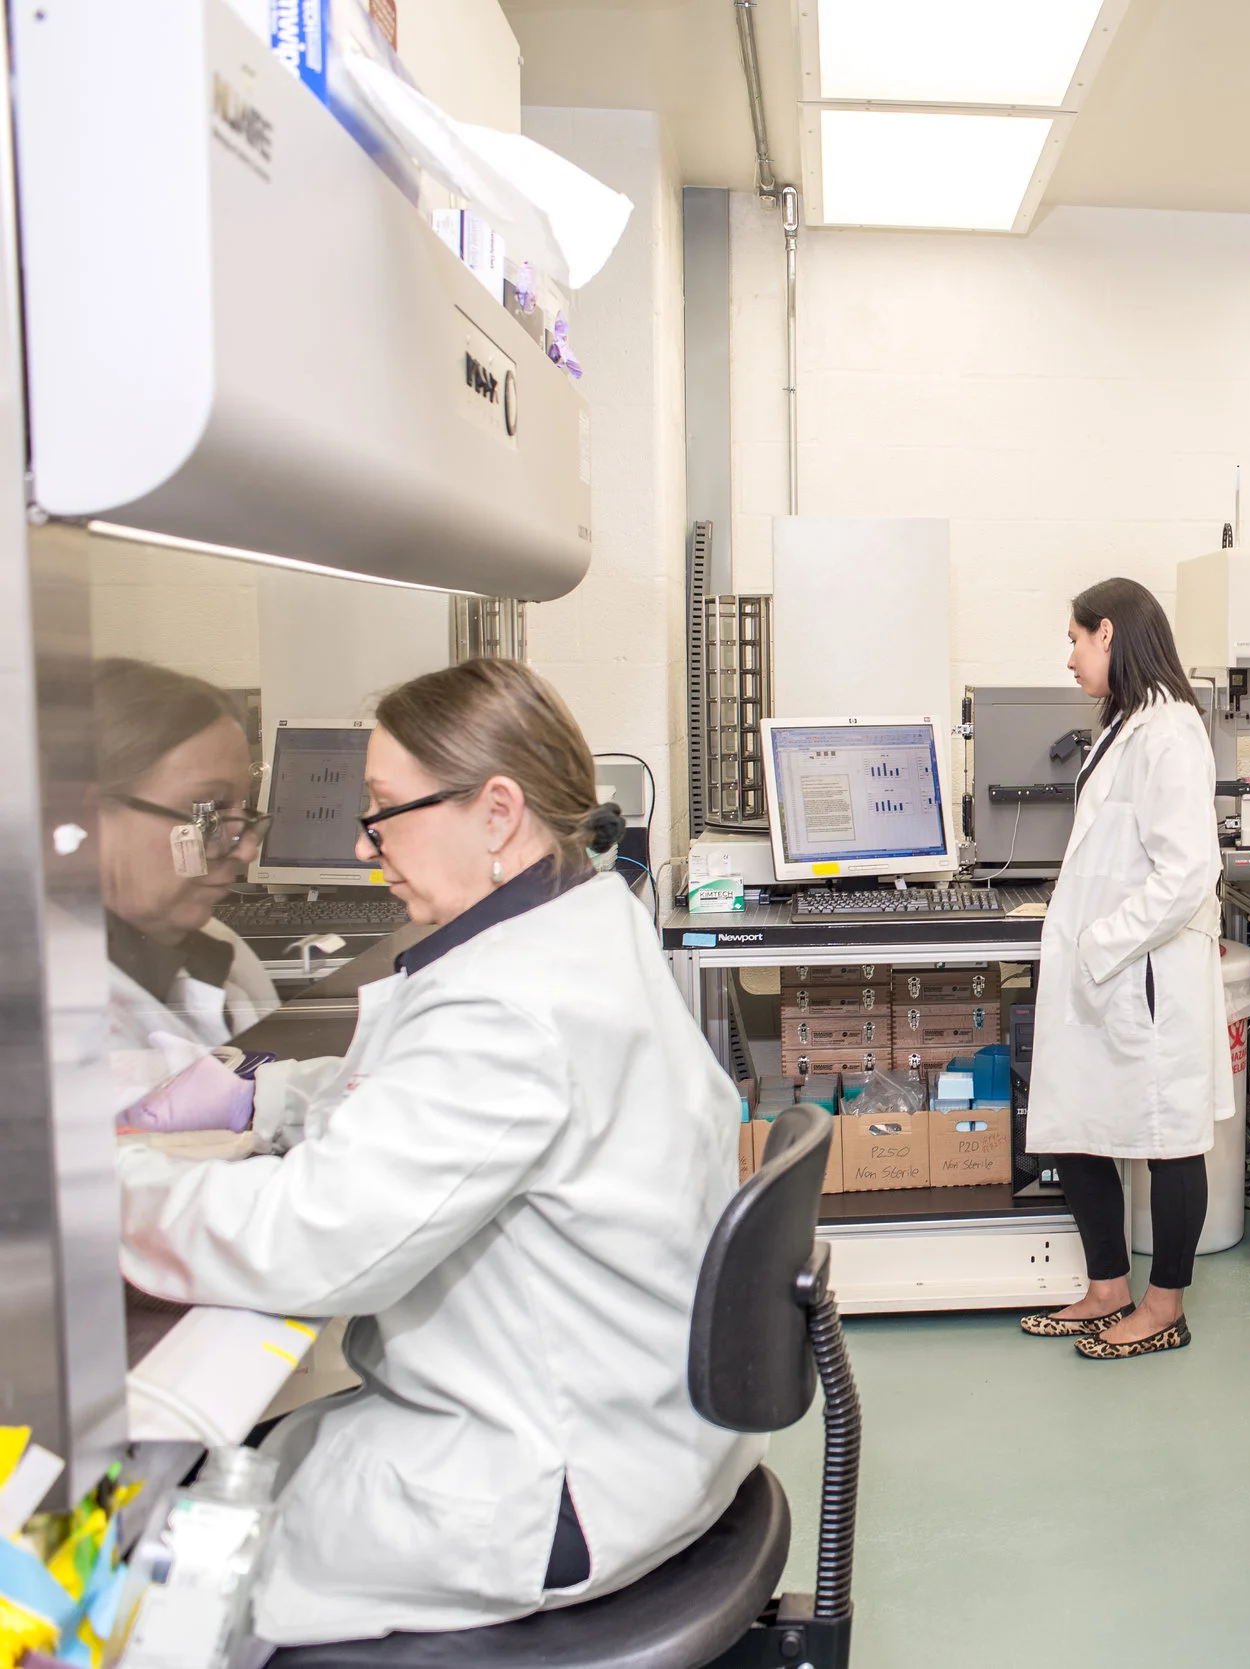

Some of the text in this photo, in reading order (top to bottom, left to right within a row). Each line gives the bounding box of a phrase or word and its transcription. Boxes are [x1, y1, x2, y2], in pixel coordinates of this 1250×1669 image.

[699, 890, 734, 898] KIMTECH
[718, 933, 764, 942] Newport
[871, 1145, 911, 1159] P250
[942, 1158, 994, 1171] Non Sterile
[855, 1164, 920, 1180] Non Sterile
